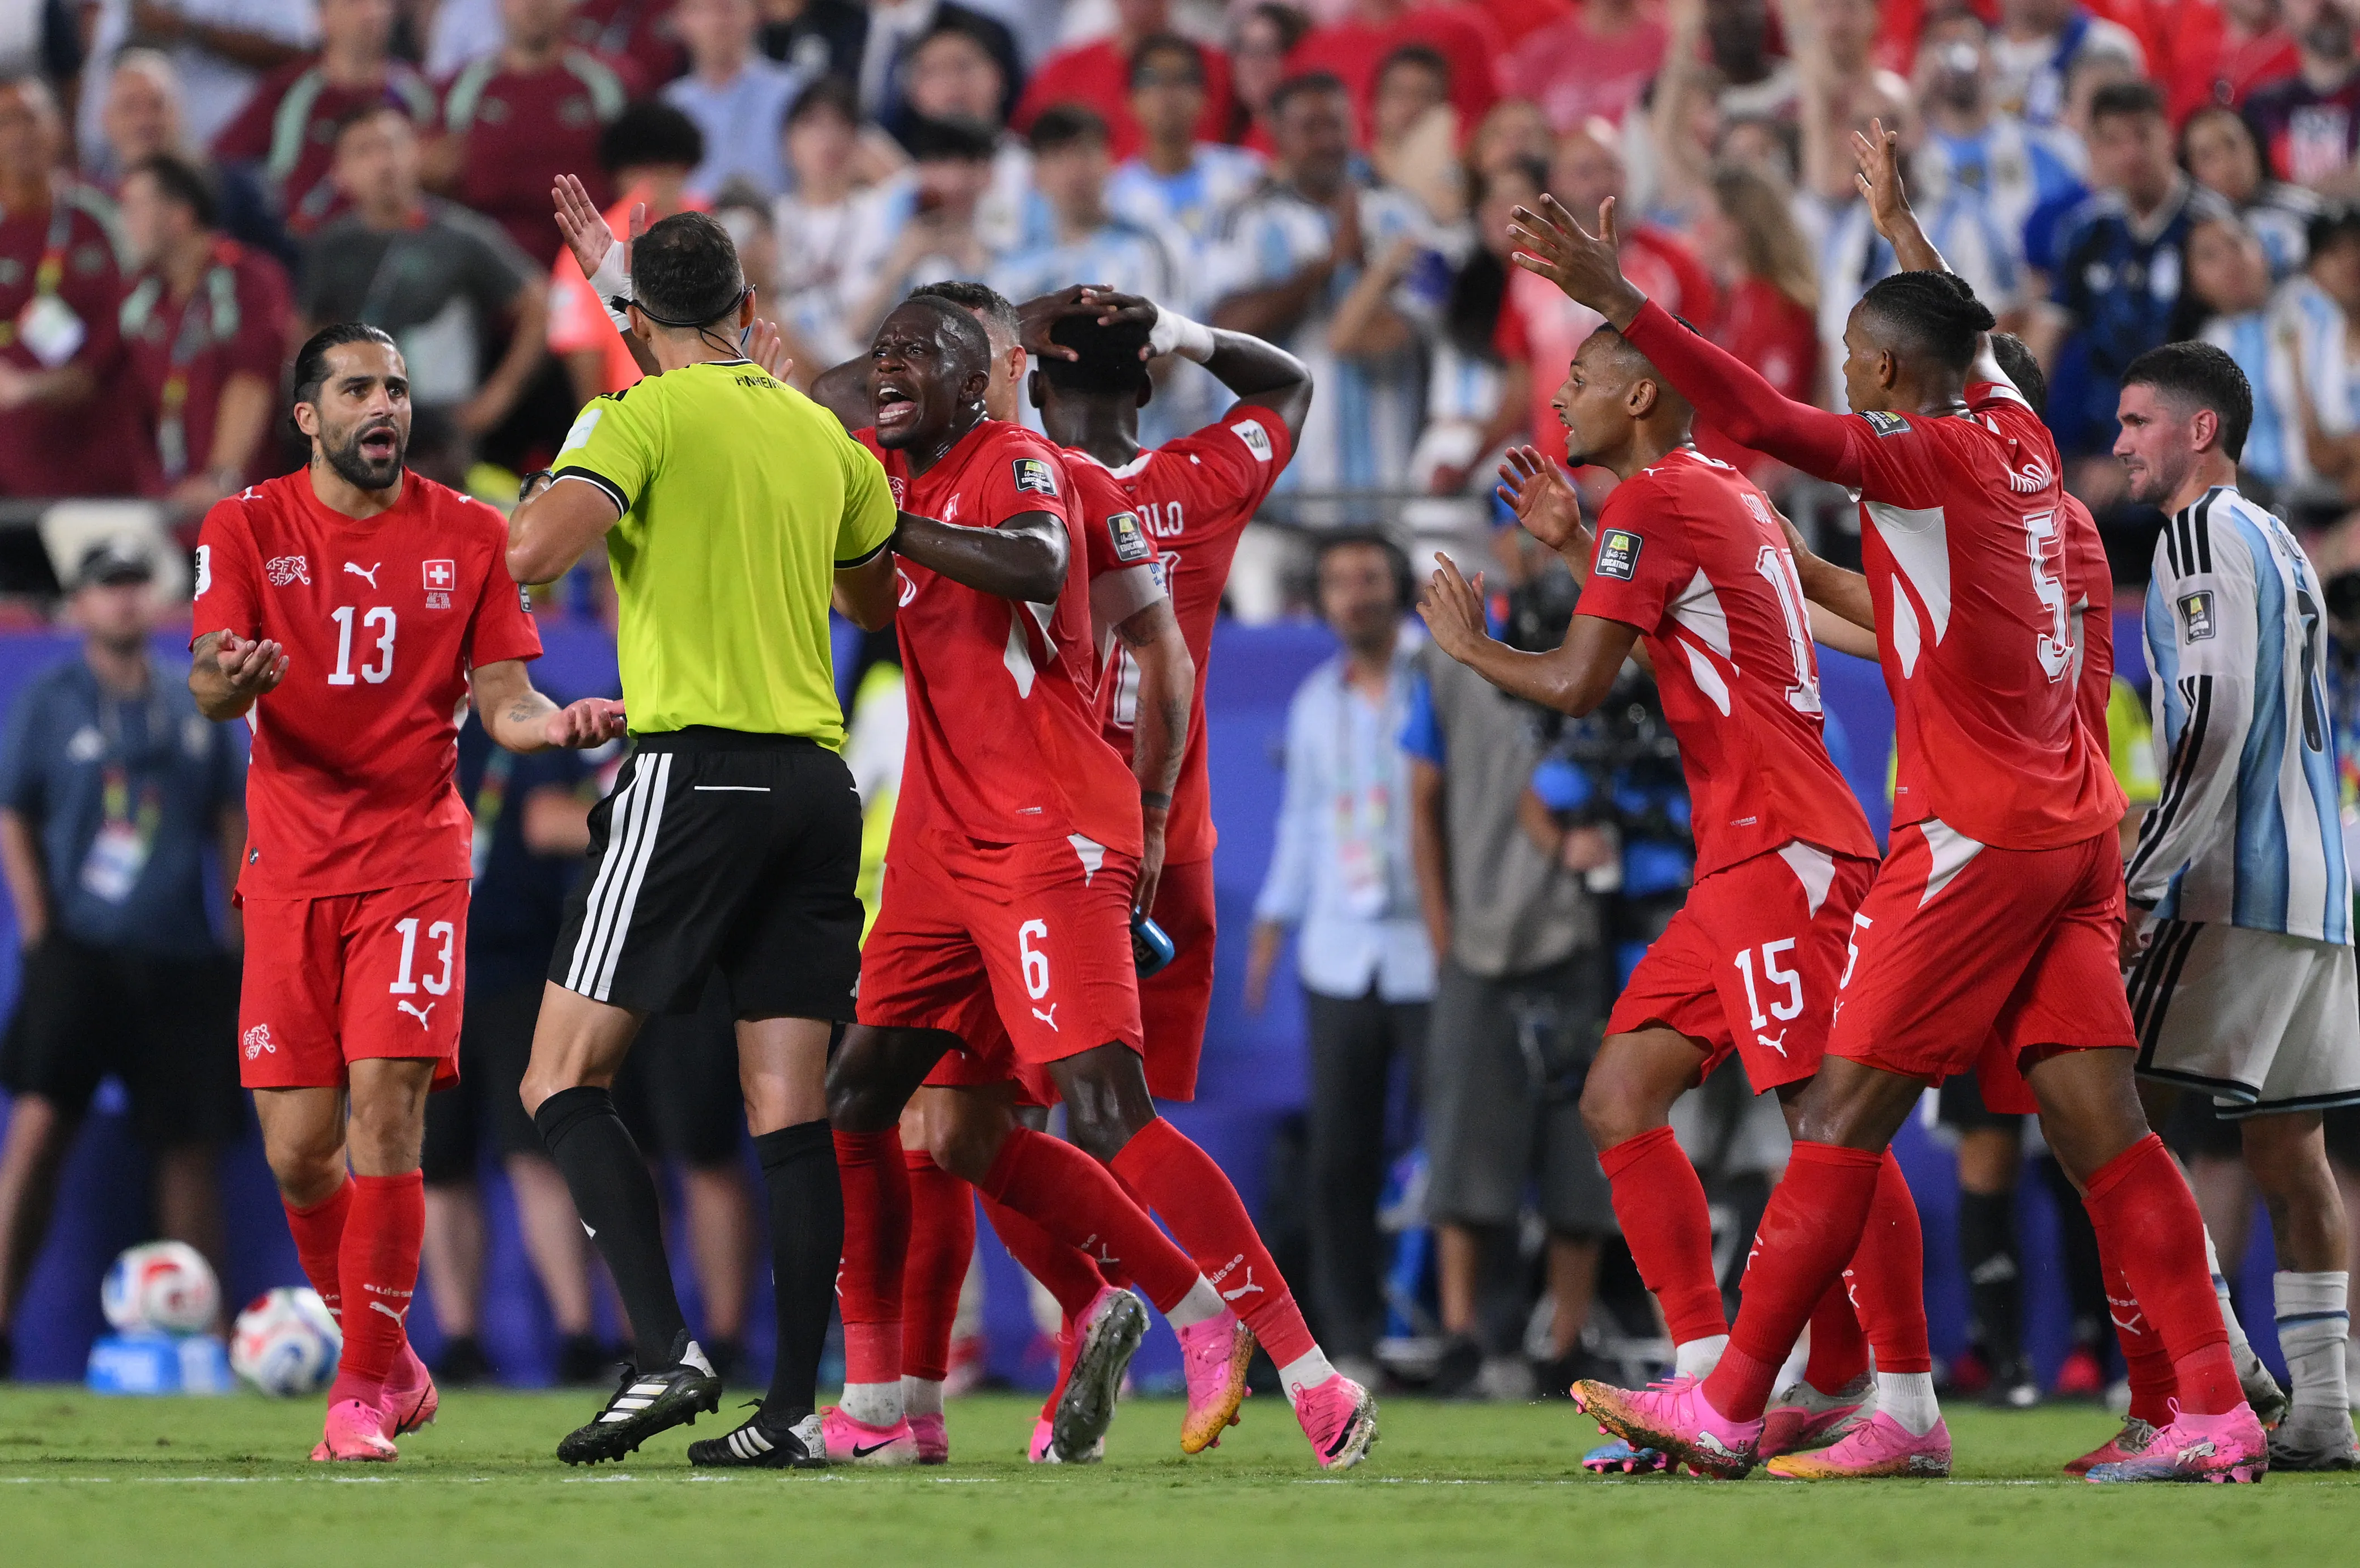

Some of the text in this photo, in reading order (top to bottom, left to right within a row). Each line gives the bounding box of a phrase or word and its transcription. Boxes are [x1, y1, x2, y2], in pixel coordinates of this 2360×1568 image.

[1601, 558, 1630, 571] EDUCATION
[2022, 509, 2076, 684] 5
[327, 606, 396, 685] 13
[389, 918, 454, 996] 13
[1019, 918, 1049, 1000] 6
[1733, 936, 1804, 1032] 15
